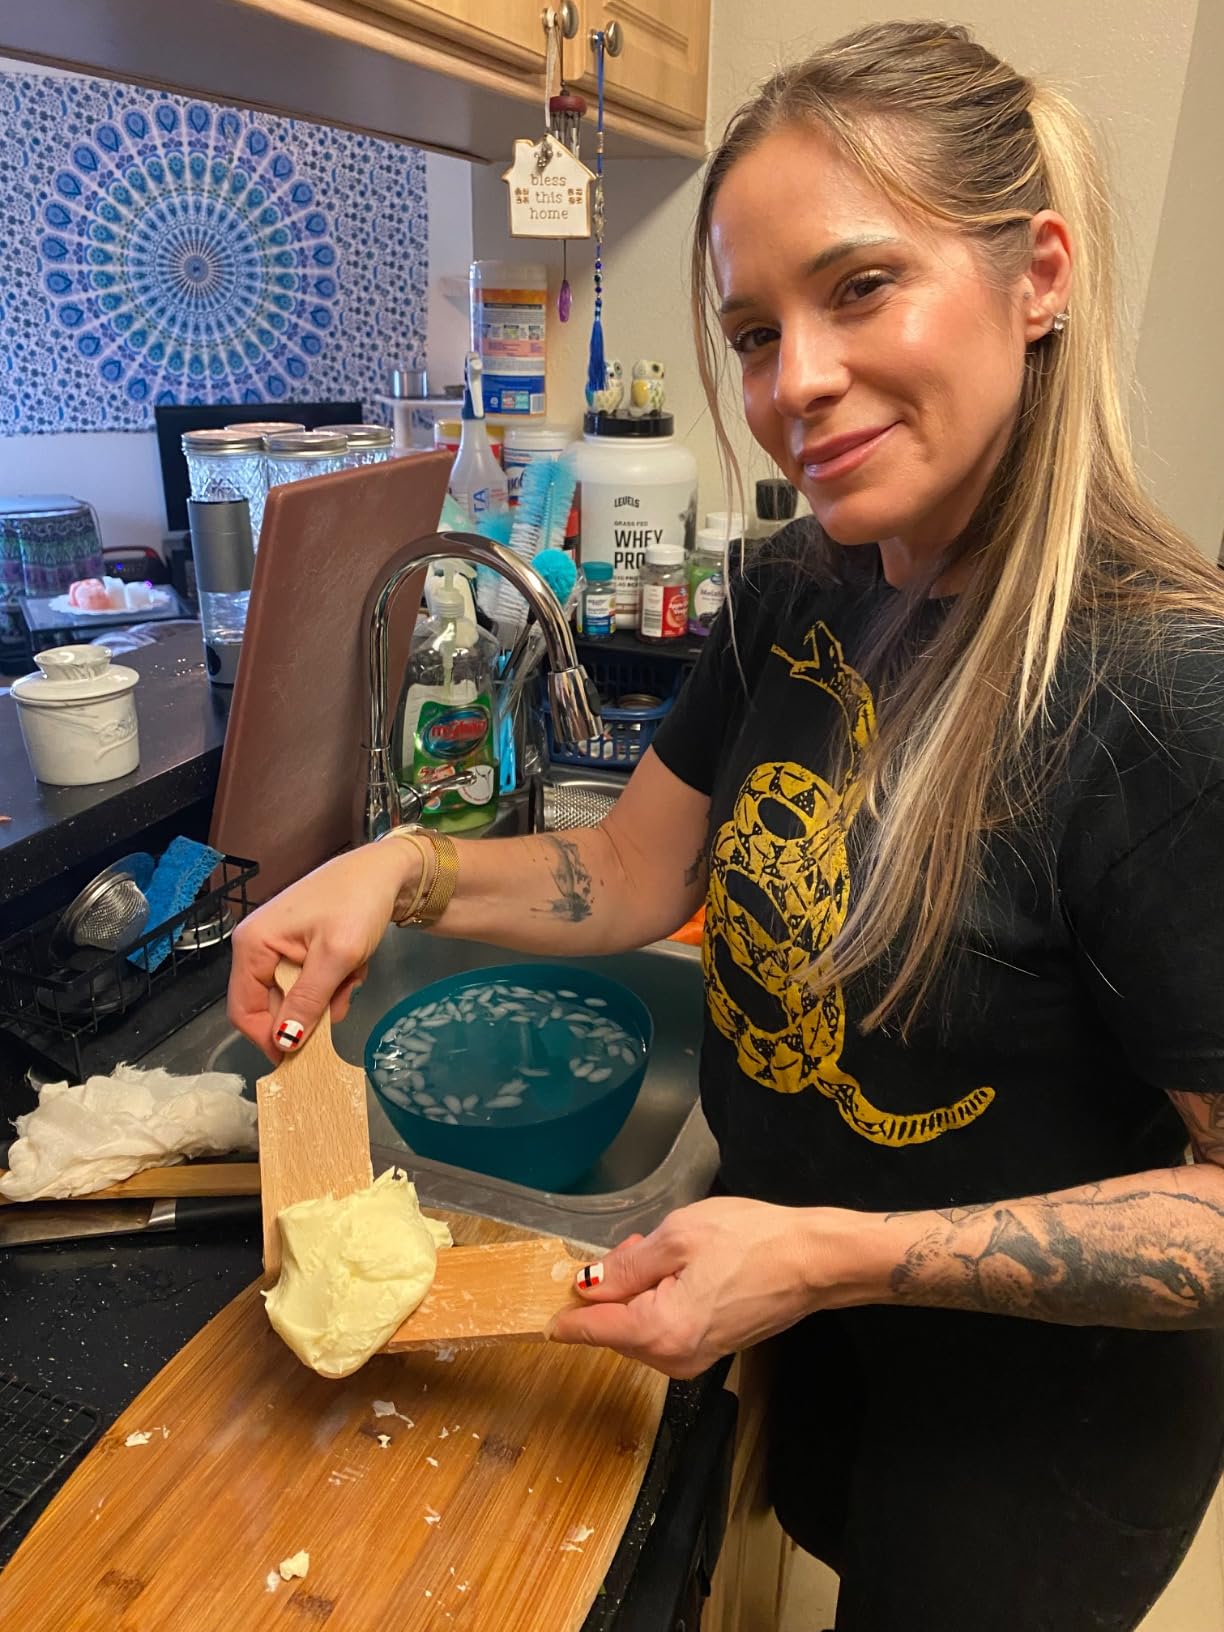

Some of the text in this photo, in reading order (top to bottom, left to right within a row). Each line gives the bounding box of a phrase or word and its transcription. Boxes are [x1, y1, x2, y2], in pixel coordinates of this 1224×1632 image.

[530, 174, 567, 186] bless
[535, 191, 563, 204] this
[530, 207, 569, 220] home
[614, 496, 640, 508] LEVELS
[614, 529, 663, 548] WHEY
[614, 551, 646, 570] PRO
